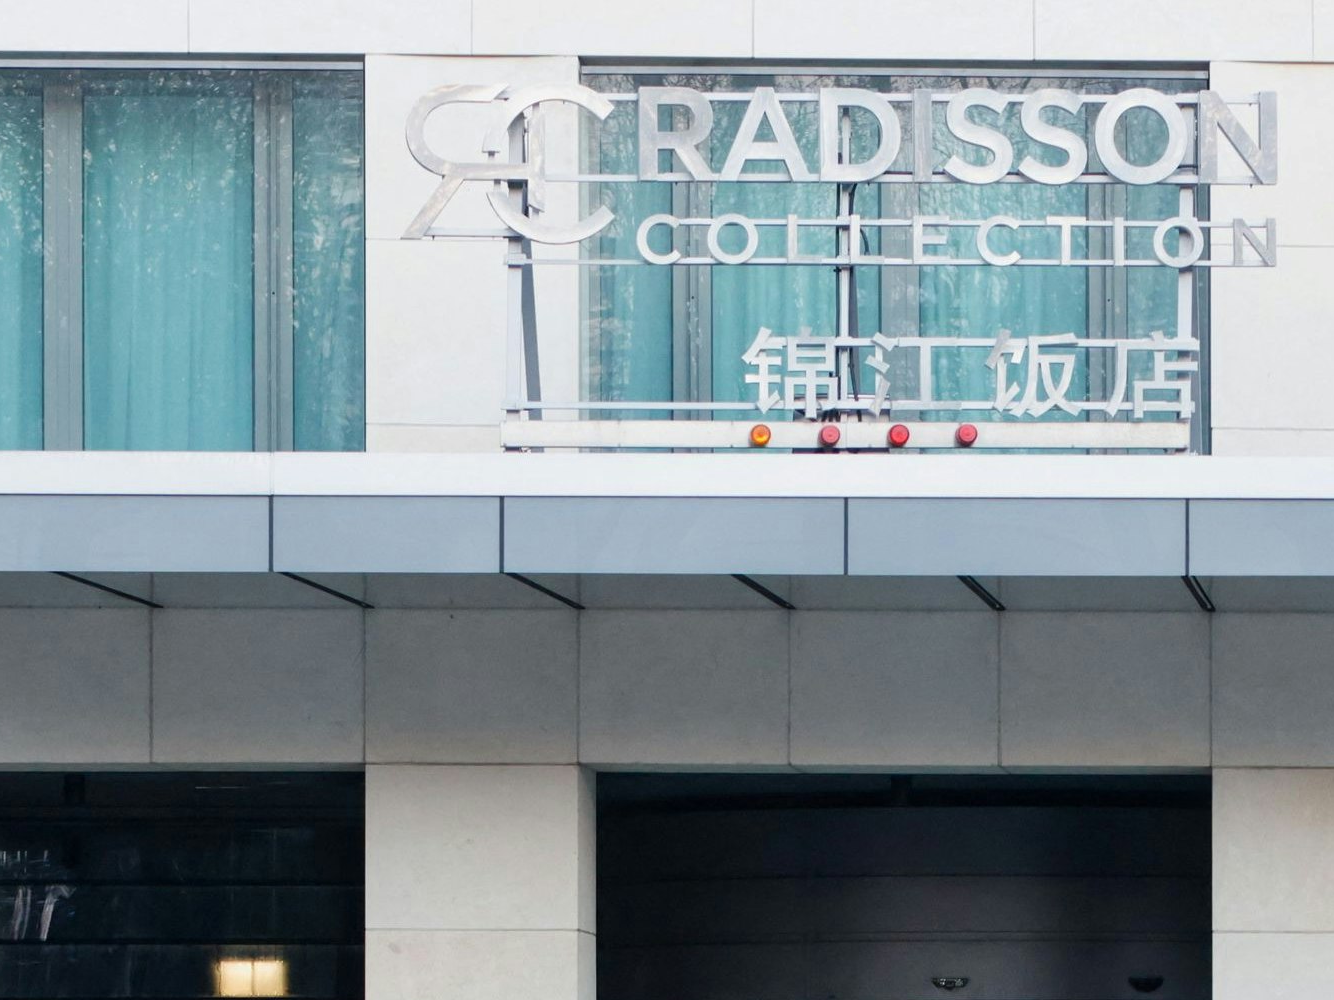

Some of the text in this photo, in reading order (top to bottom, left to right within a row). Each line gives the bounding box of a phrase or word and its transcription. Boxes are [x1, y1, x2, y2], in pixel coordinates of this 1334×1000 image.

[639, 86, 1277, 186] RADISSON
[636, 214, 1277, 268] COLLECTION
[741, 326, 1200, 420] 锦江饭店
